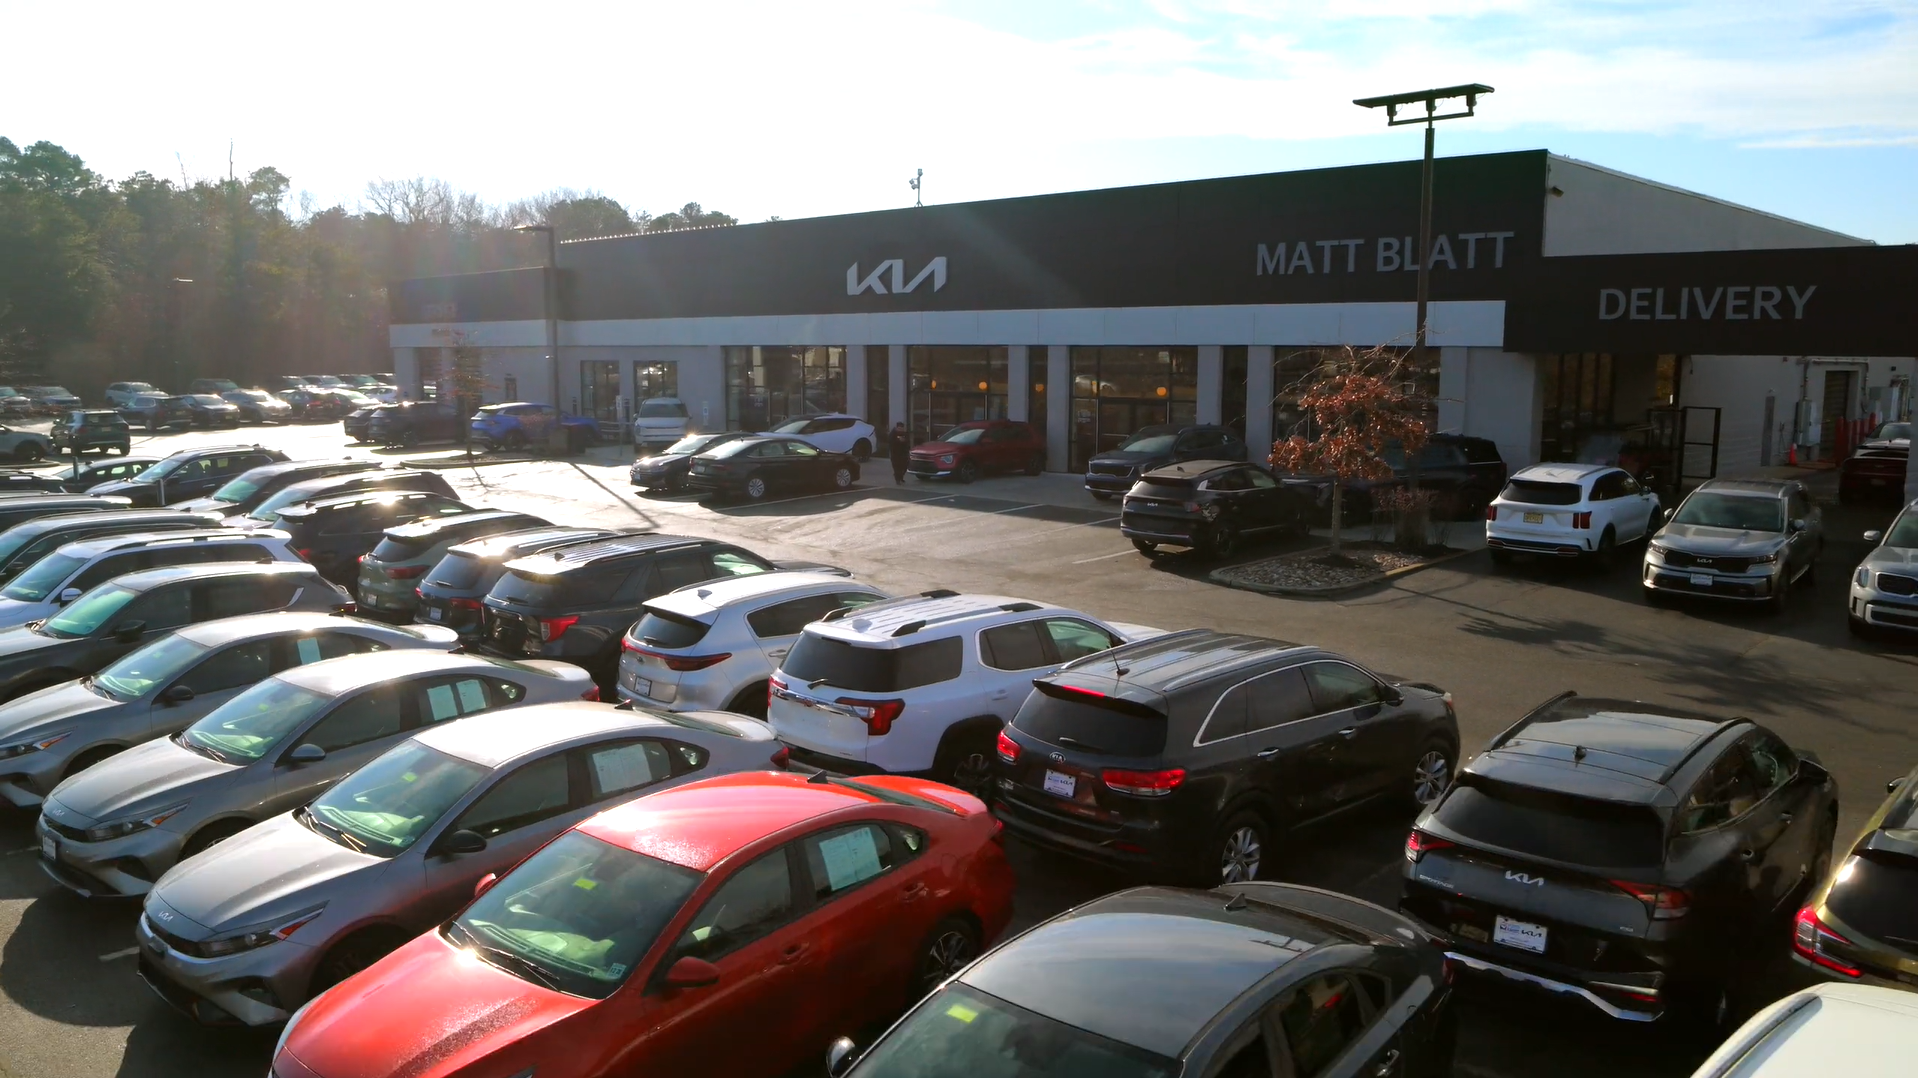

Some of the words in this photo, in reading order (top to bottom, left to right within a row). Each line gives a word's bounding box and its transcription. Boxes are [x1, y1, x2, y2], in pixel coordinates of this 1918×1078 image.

[1257, 238, 1365, 275] MATT
[1376, 231, 1515, 272] BLATT
[846, 256, 947, 295] KIA
[1598, 285, 1818, 320] DELIVERY
[1505, 870, 1544, 886] KIA
